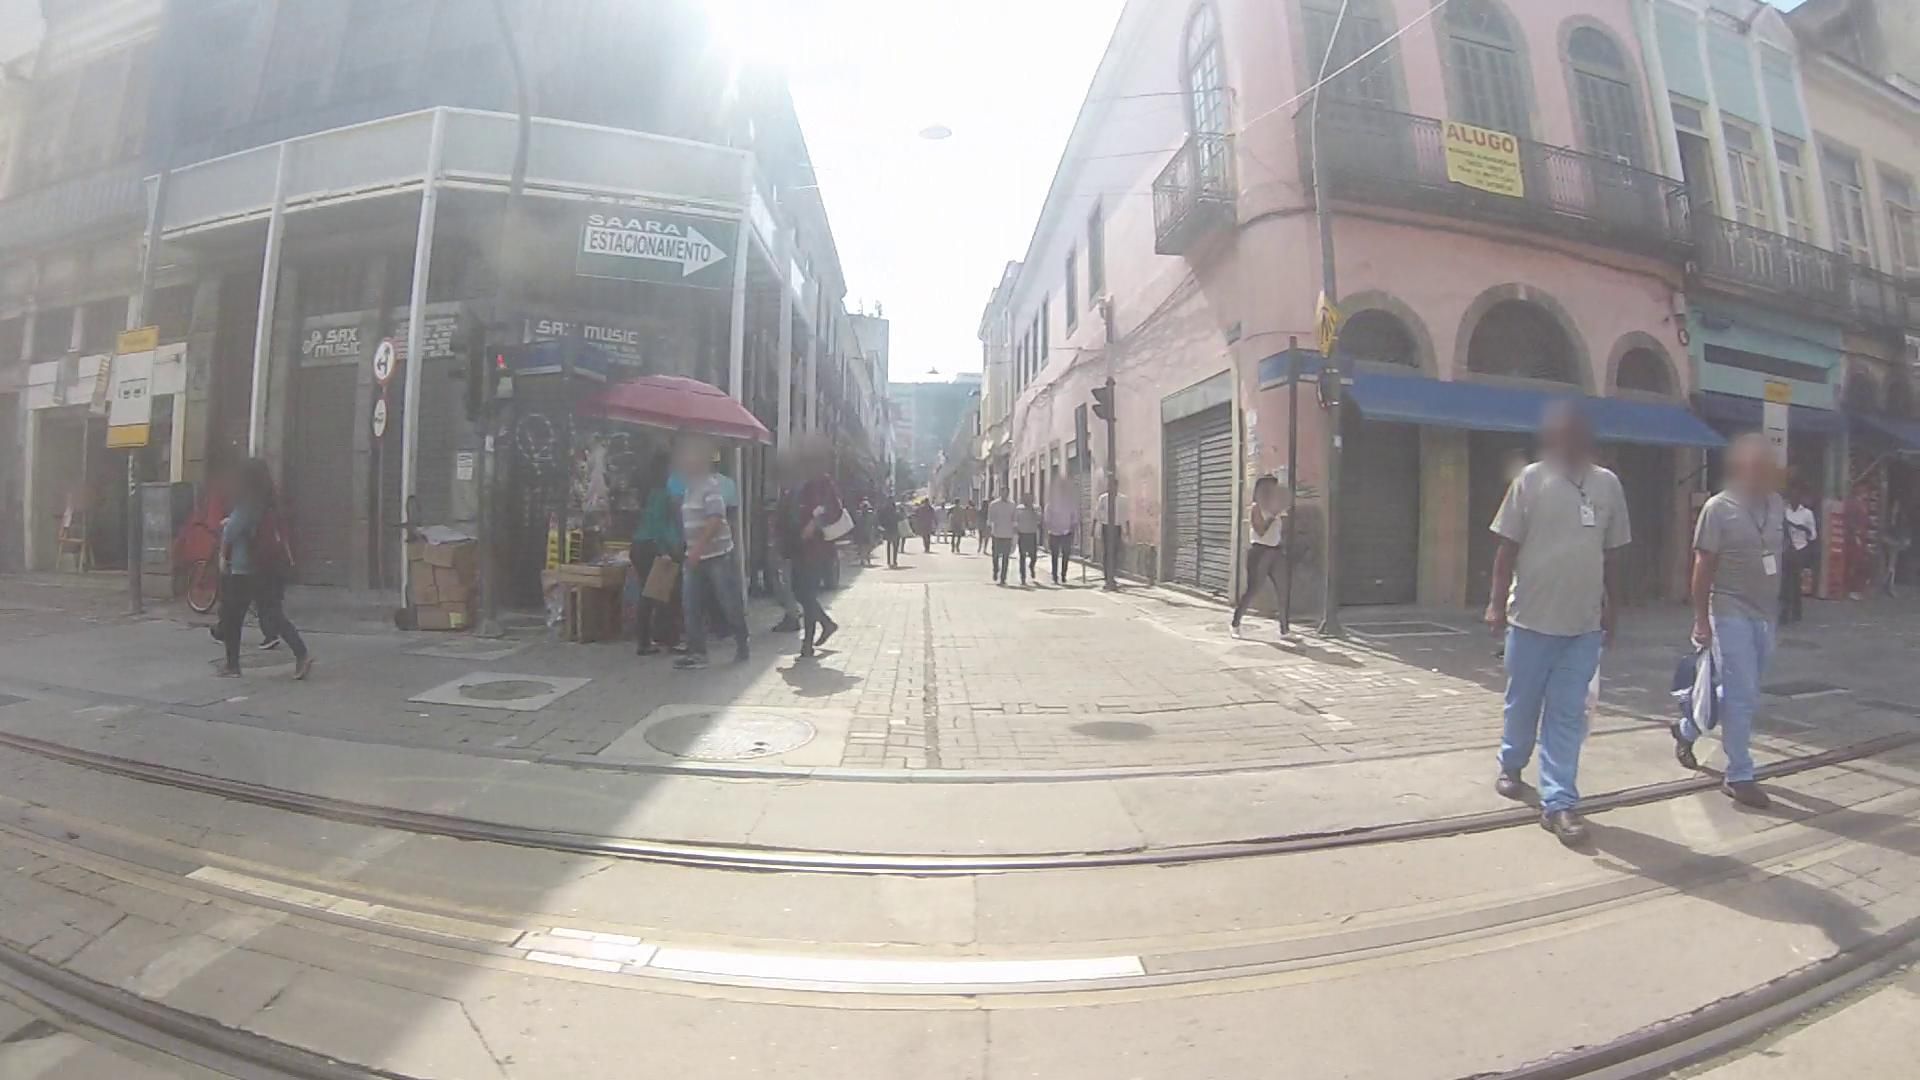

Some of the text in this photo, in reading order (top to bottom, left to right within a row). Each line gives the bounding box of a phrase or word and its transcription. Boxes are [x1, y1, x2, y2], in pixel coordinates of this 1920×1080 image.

[1447, 124, 1515, 154] ALUGO
[588, 214, 681, 236] SAARA
[589, 230, 712, 262] ESTACIONAMENTO
[325, 327, 358, 344] SAX
[584, 325, 639, 345] MUSIC
